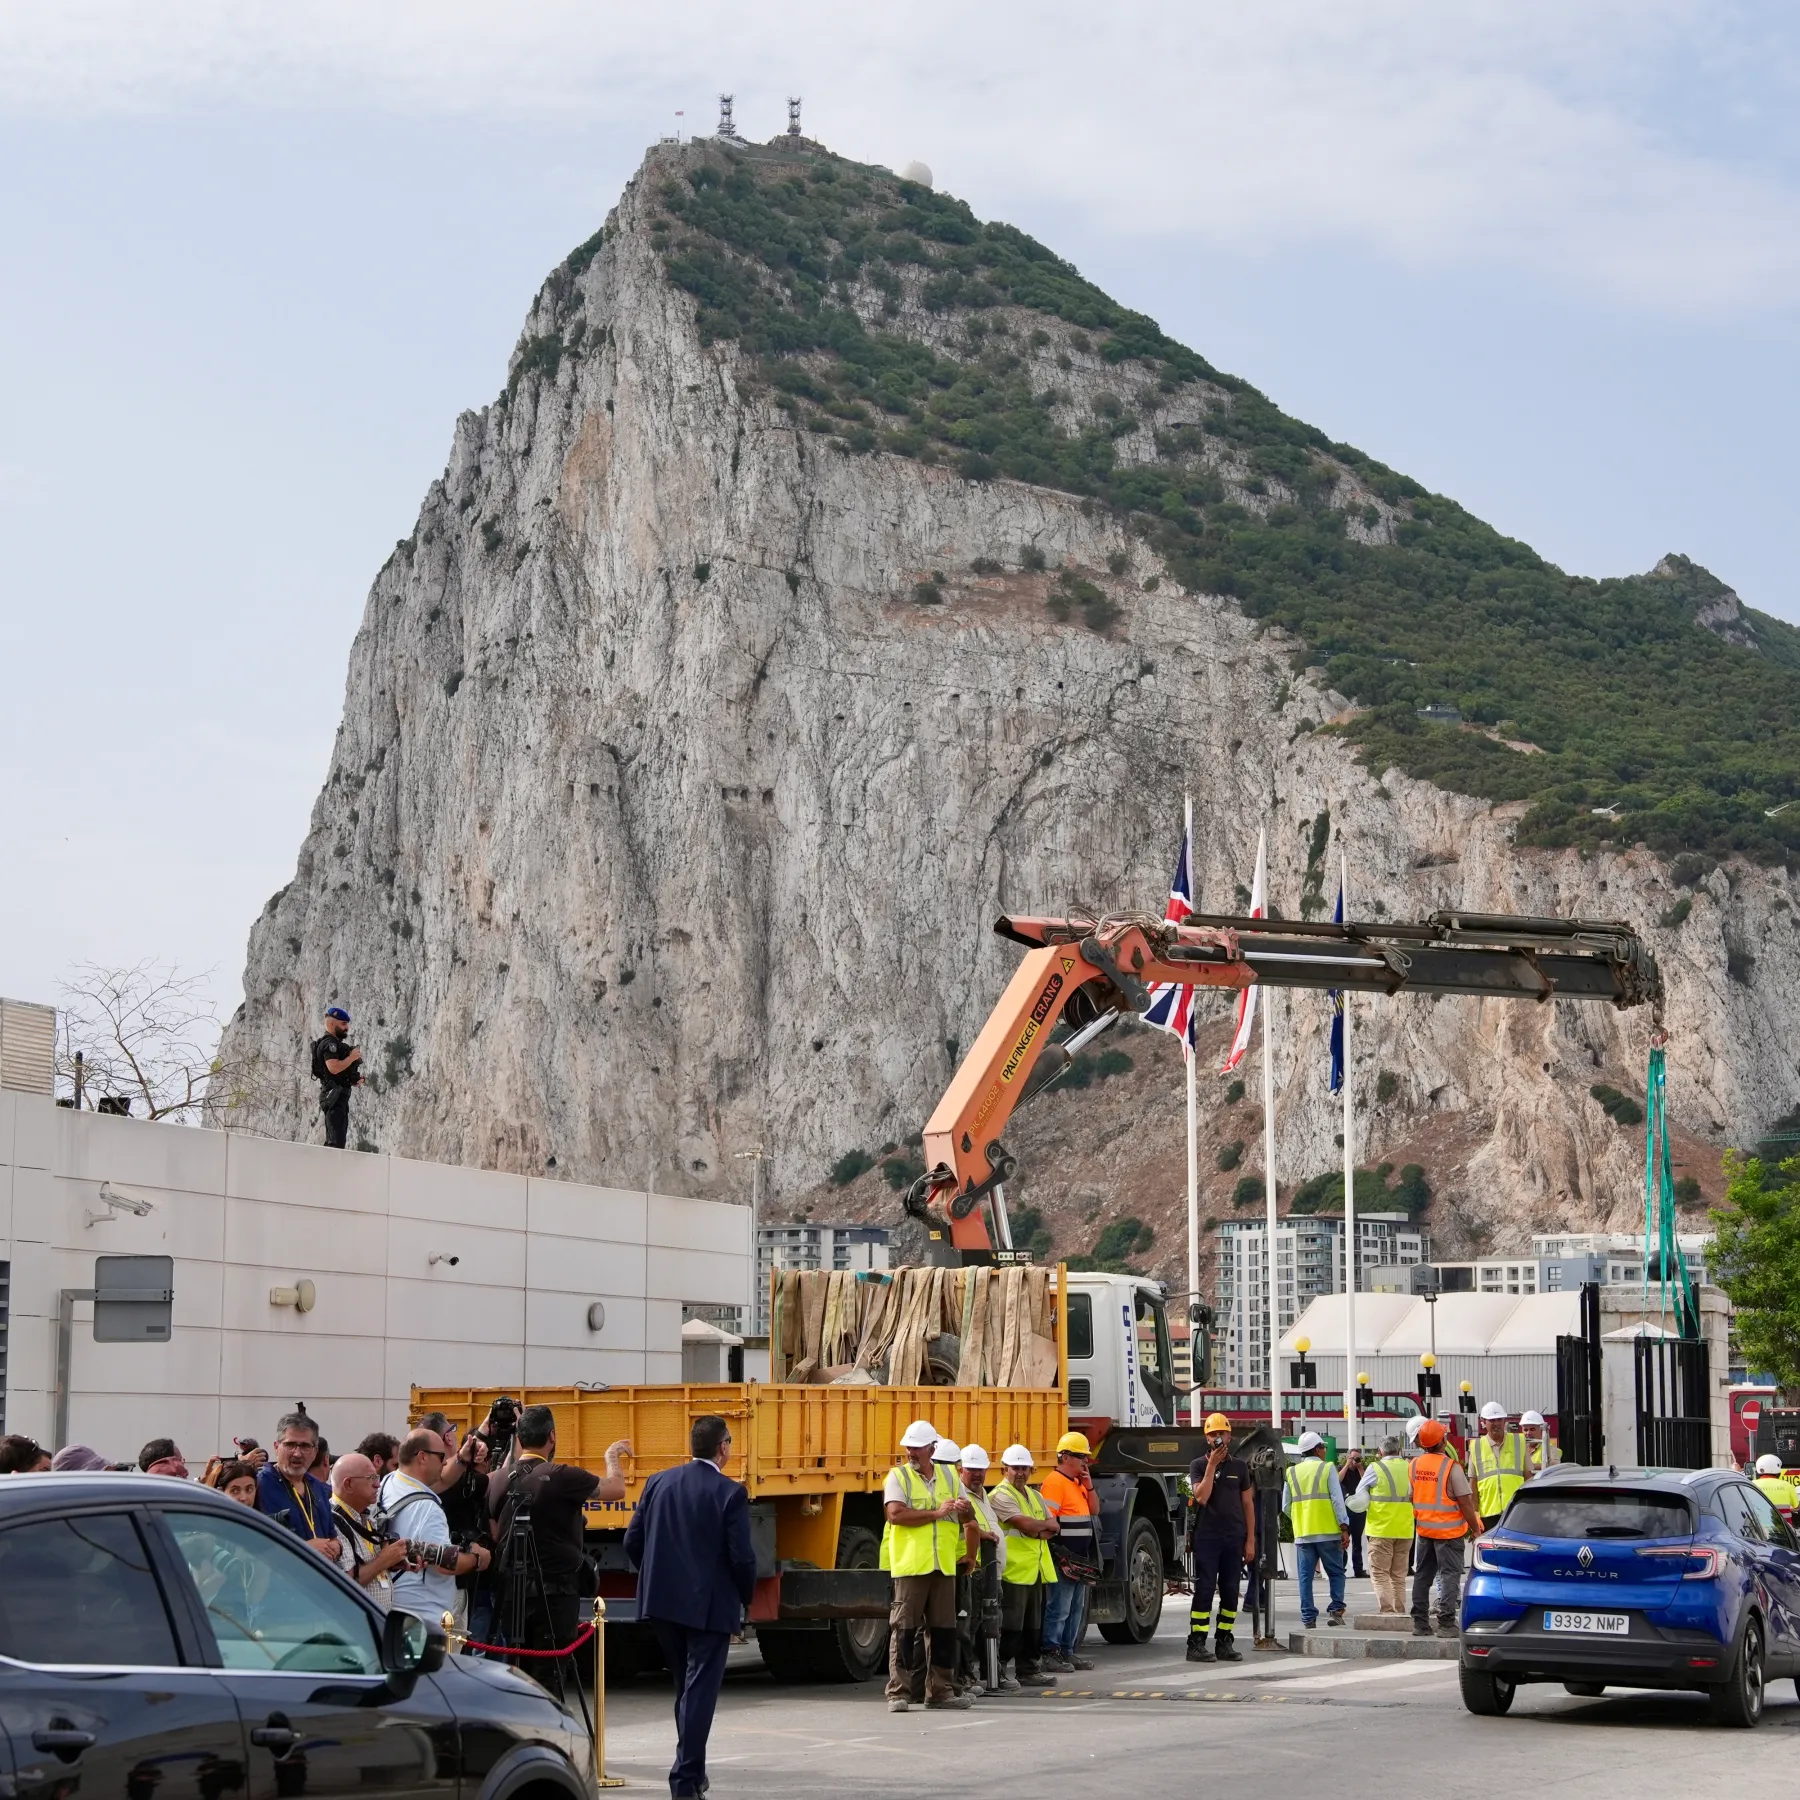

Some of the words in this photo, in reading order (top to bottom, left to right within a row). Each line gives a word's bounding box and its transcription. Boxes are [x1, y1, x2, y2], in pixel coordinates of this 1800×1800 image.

[1002, 1021, 1038, 1080] PALFINGER
[1034, 978, 1060, 1021] CRANE
[969, 1120, 980, 1135] PK
[978, 1085, 1000, 1120] 44002
[582, 1502, 637, 1511] ASTILL
[1553, 1570, 1618, 1579] CAPTUR
[1554, 1615, 1592, 1629] 9392
[1597, 1616, 1625, 1631] NMP
